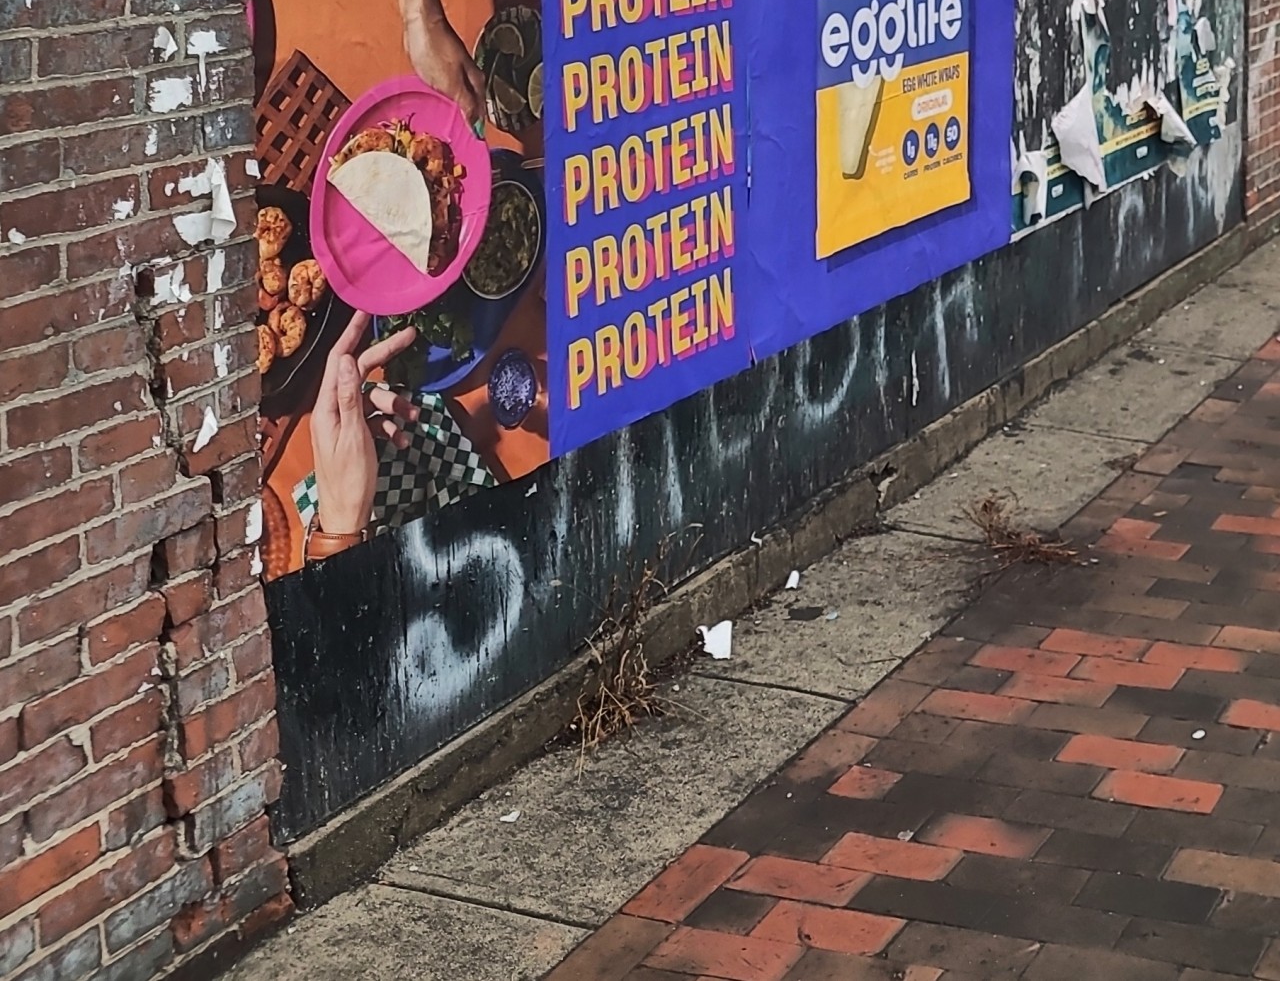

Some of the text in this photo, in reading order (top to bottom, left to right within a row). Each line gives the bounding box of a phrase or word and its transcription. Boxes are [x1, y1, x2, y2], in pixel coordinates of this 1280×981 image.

[563, 20, 734, 133] PROTEIN
[946, 124, 959, 142] 50
[565, 103, 734, 226] PROTEIN
[566, 185, 734, 319] PROTEIN
[568, 267, 734, 410] PROTEIN
